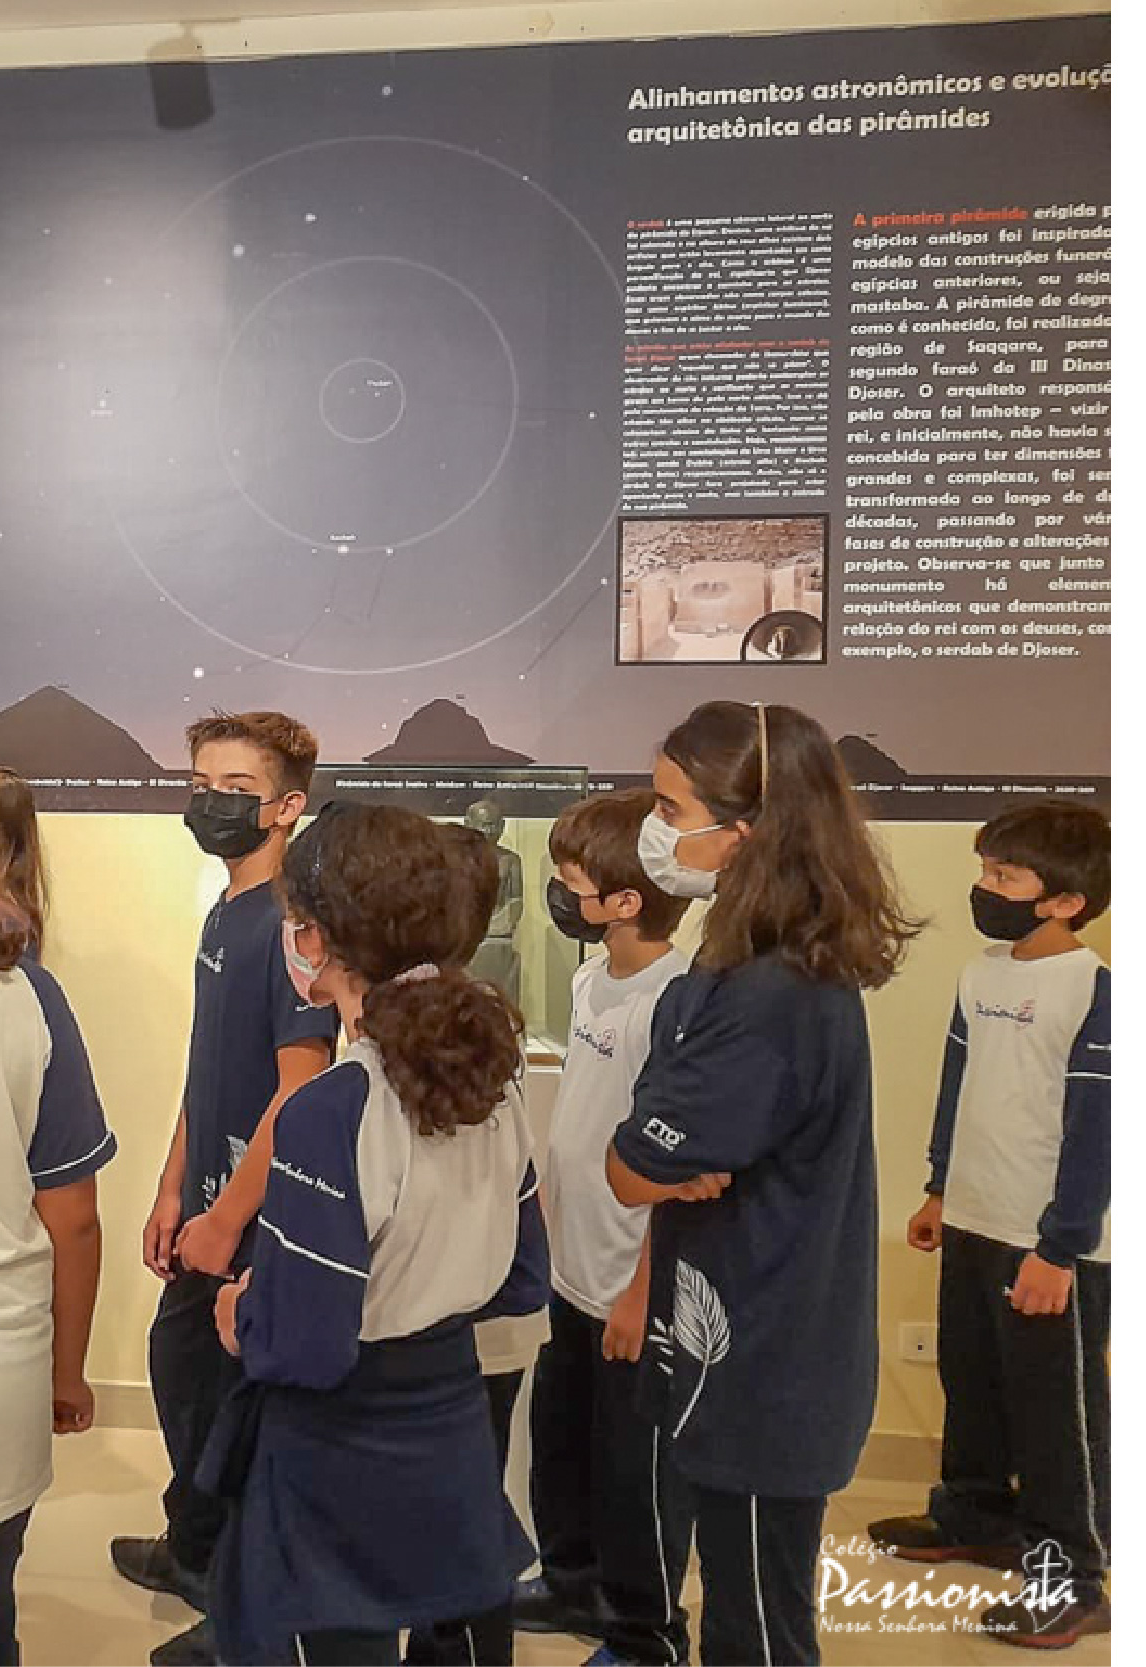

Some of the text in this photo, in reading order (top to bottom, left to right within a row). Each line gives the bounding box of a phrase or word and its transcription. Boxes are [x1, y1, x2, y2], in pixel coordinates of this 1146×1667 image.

[629, 83, 805, 109] Alinhamentos
[811, 74, 981, 100] astronômicos
[989, 76, 1005, 91] e
[627, 106, 989, 145] arquitetônica das pirâmides
